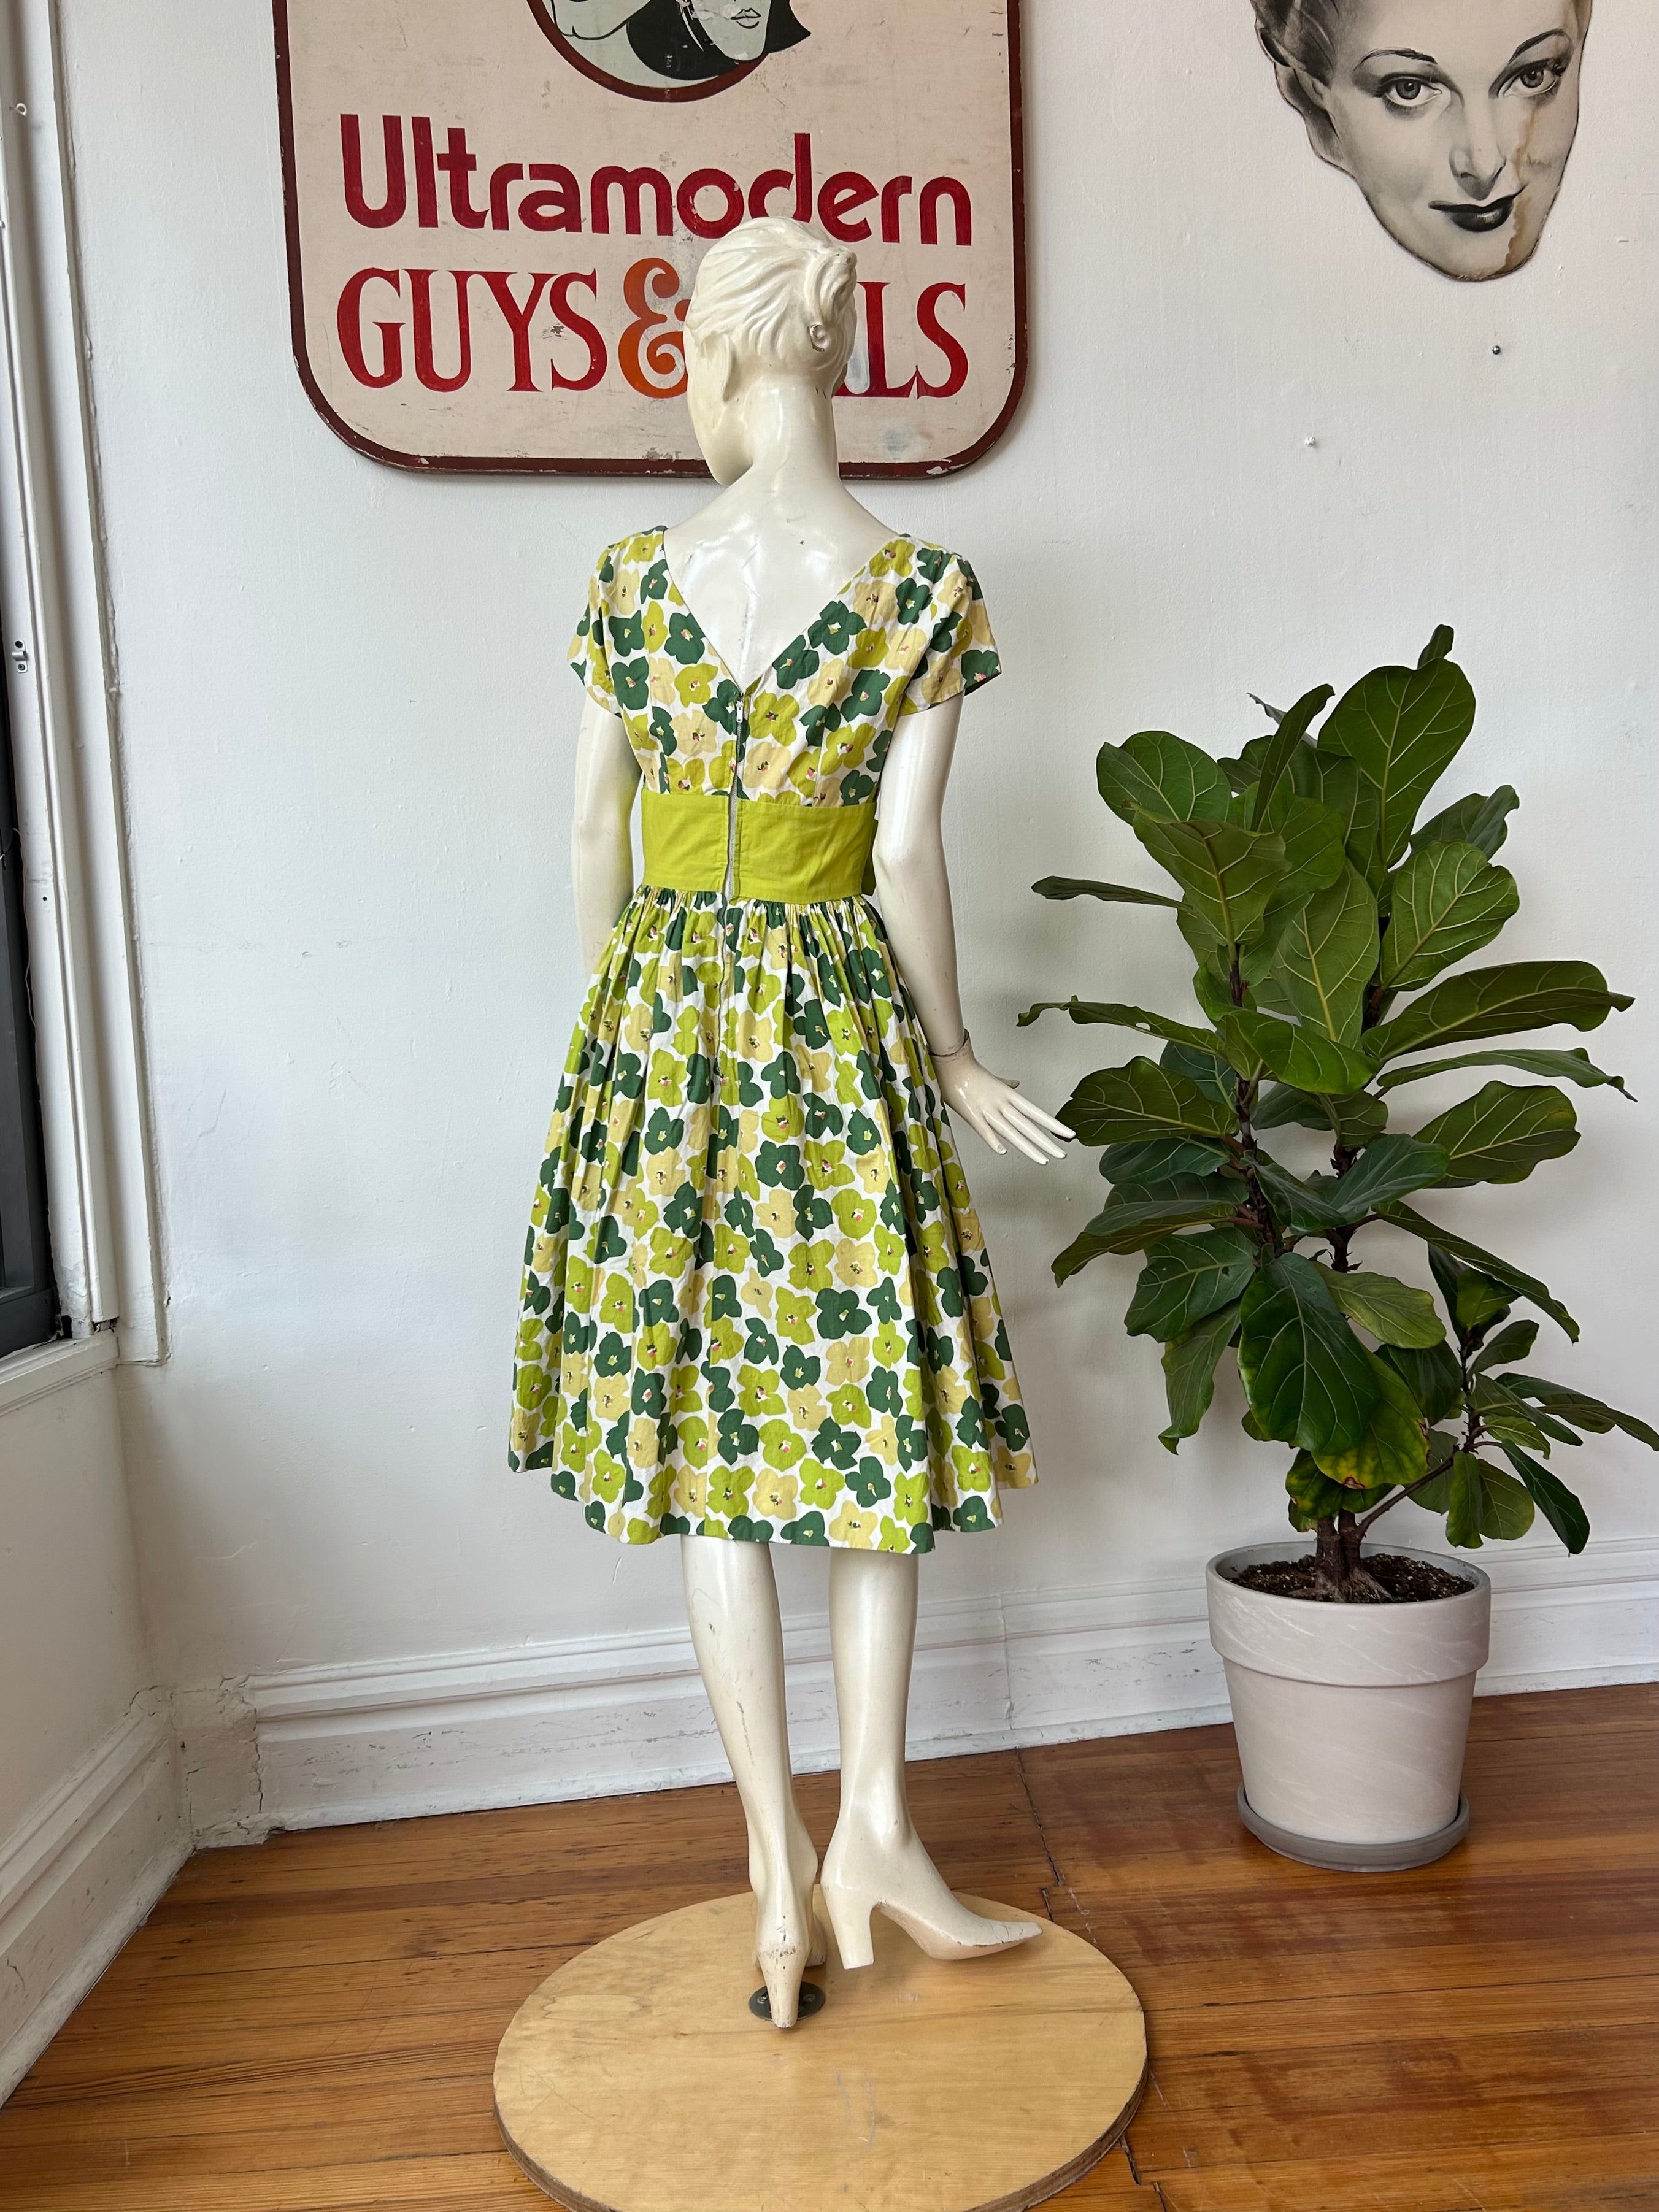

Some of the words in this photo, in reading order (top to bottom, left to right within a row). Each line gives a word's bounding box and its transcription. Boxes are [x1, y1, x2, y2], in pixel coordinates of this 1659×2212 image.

[340, 114, 972, 246] Ultramodern
[337, 267, 607, 393] GUYS
[618, 258, 690, 399] &
